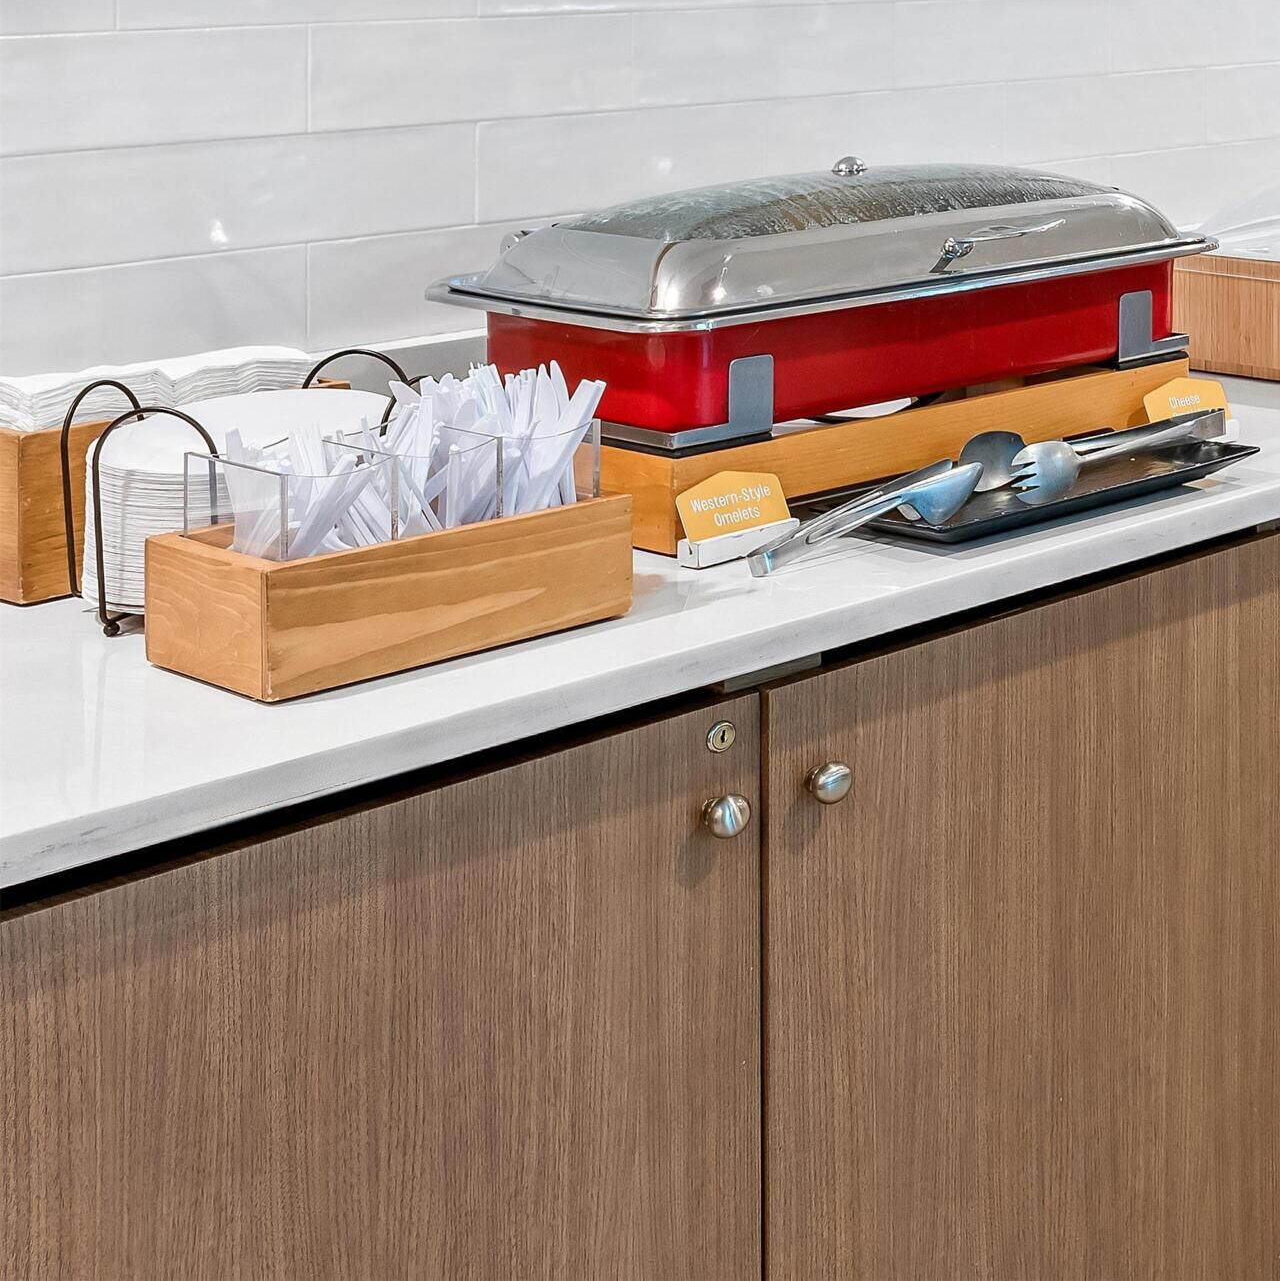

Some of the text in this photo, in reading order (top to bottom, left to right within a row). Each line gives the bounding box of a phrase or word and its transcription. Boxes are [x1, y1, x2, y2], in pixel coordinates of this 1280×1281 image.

[1168, 393, 1201, 409] Cheese
[690, 483, 772, 514] Western-Style
[713, 506, 761, 527] Omelets
